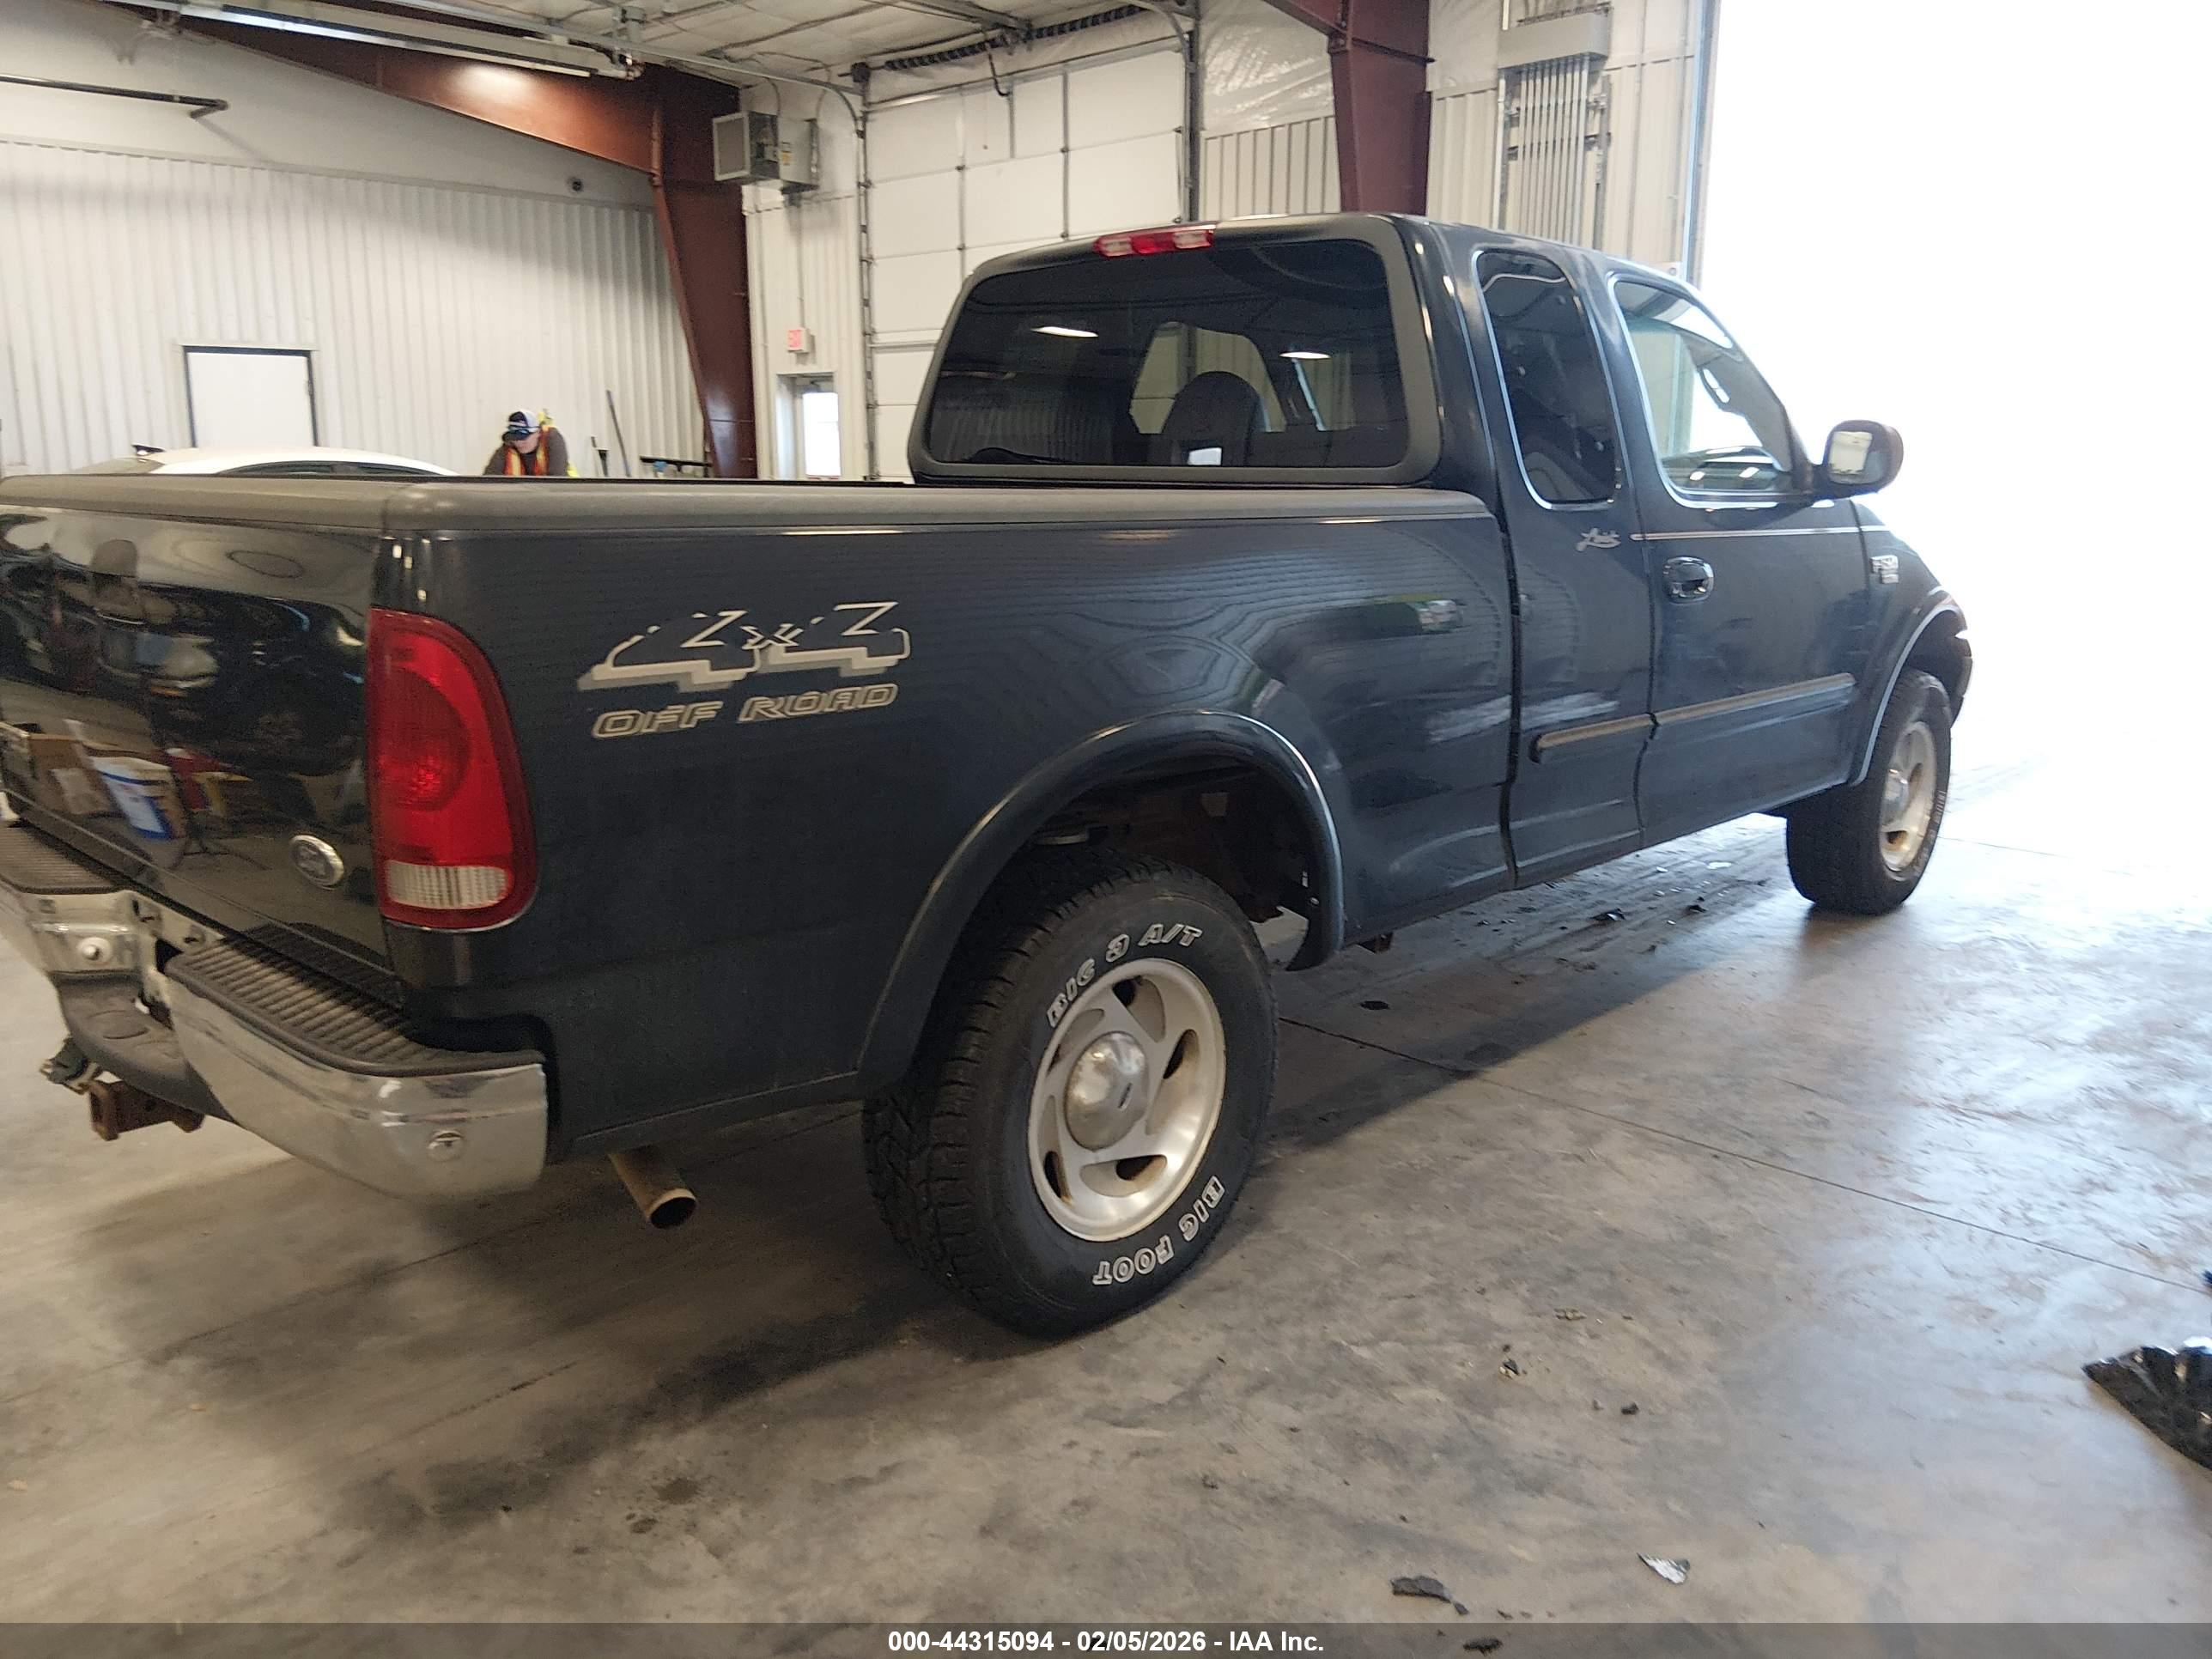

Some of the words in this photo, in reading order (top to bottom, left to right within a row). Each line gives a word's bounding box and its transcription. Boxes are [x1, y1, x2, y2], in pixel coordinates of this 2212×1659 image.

[592, 701, 724, 738] OFF
[737, 684, 899, 723] ROAD
[1046, 957, 1096, 1029] BIG
[1137, 923, 1203, 947] A/T
[1178, 1175, 1226, 1242] BIG
[1091, 1234, 1175, 1285] FOOT
